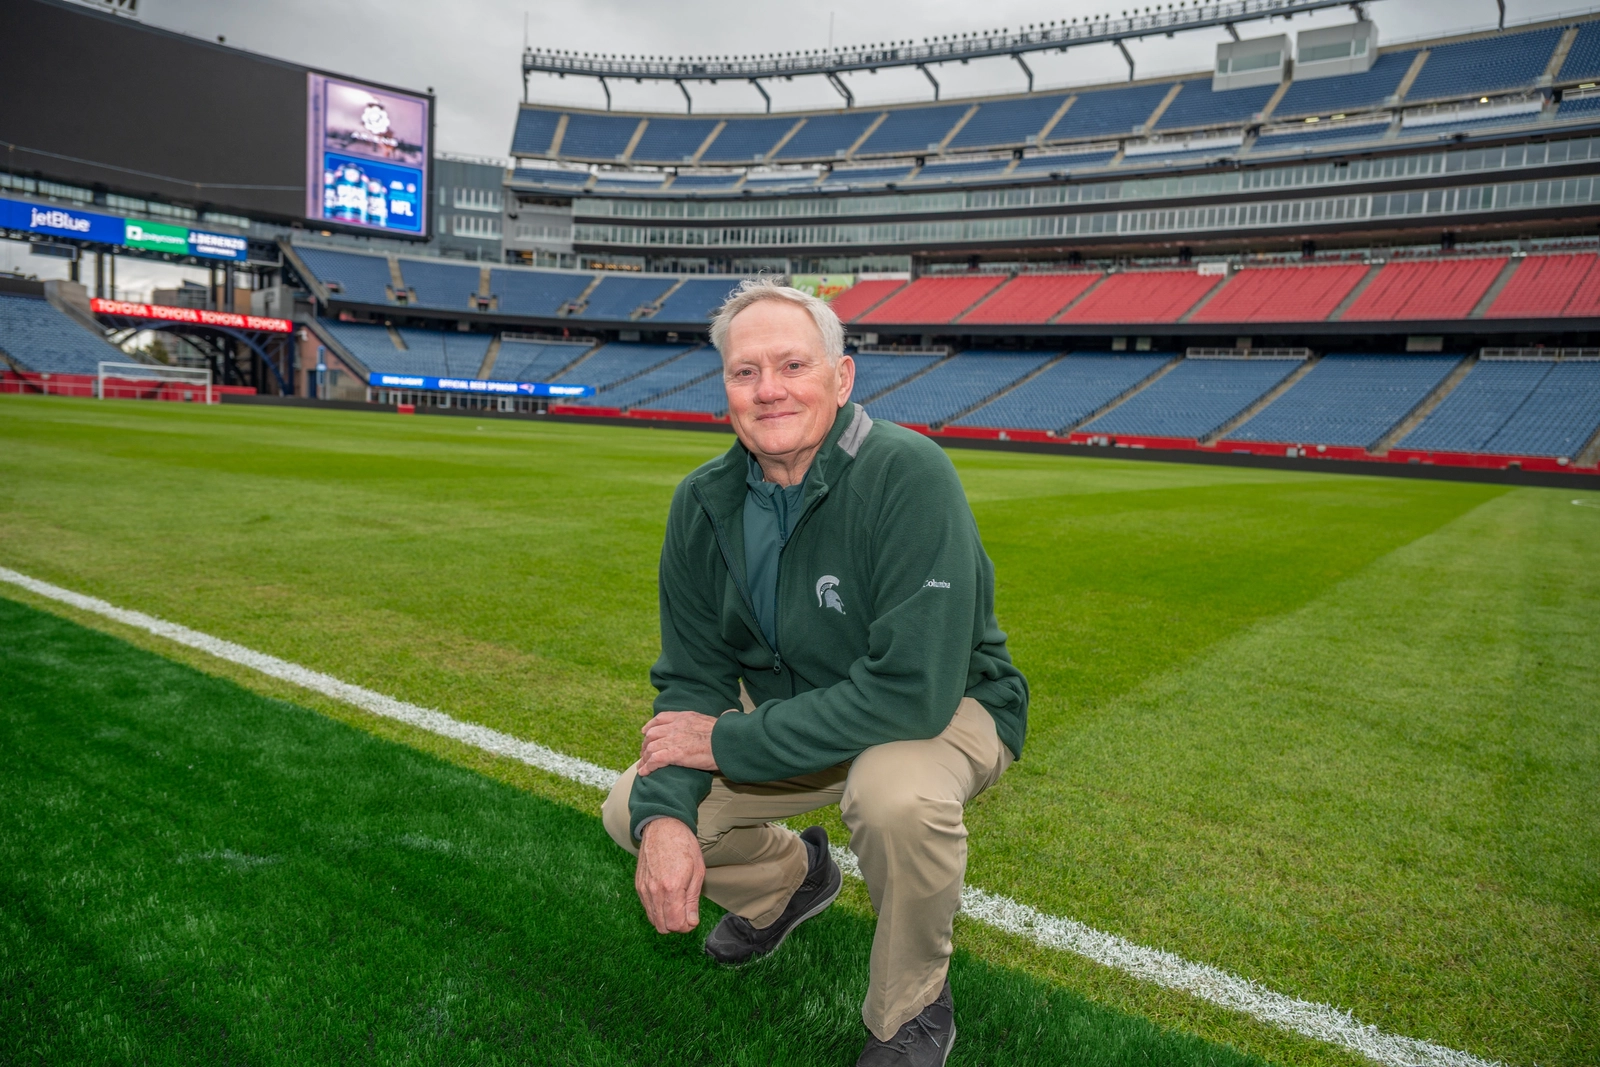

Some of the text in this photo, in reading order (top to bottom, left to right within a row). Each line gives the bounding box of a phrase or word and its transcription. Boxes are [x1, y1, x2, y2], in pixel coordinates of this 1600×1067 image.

[391, 200, 413, 217] NFL
[30, 207, 91, 233] jetBlue
[97, 299, 288, 332] TOYOTA TOYOTA TOYOTA TOYOTA
[922, 578, 950, 588] Columbia
